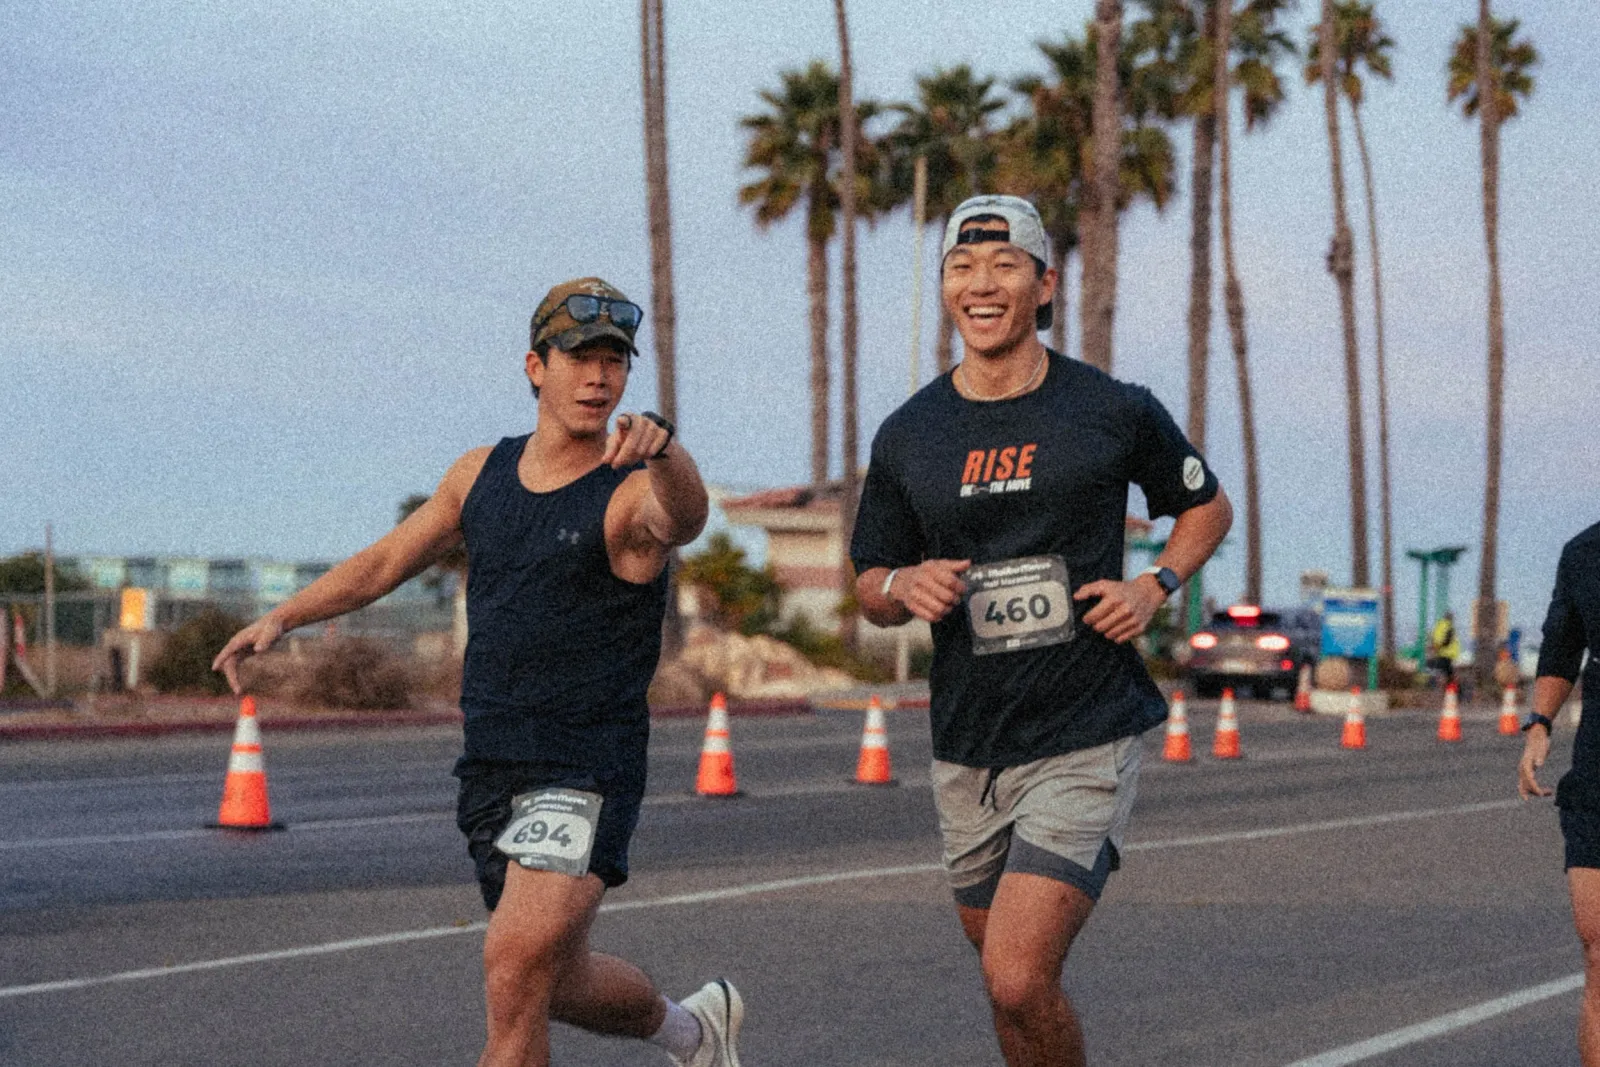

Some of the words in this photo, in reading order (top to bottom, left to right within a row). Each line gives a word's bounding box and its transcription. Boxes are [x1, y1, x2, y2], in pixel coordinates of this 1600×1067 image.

[961, 443, 1038, 484] RISE
[985, 594, 1051, 625] 460
[512, 820, 572, 848] 694
